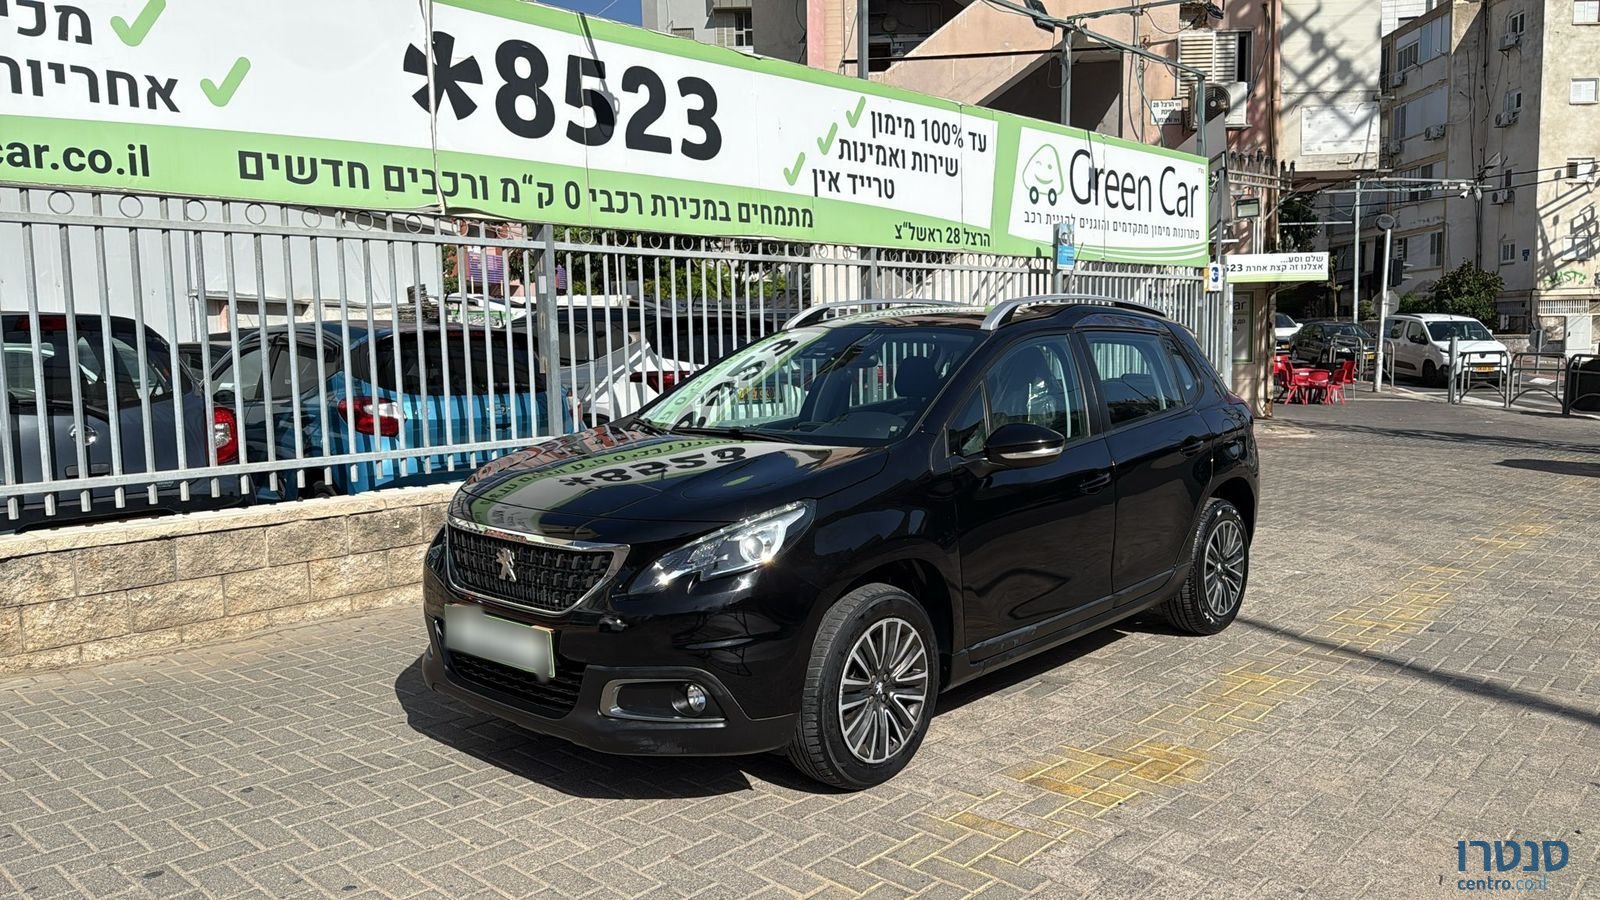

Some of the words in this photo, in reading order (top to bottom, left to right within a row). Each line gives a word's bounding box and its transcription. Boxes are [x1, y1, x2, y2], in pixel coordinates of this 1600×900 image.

[870, 111, 915, 139] מימון
[921, 119, 964, 148] 100%
[838, 138, 906, 169] ואמינות
[967, 131, 987, 153] עד
[0, 142, 150, 177] ar.co.il
[238, 150, 370, 190] חדשים
[911, 151, 959, 177] שירות
[383, 165, 489, 202] ורכבים
[812, 168, 841, 198] אין
[846, 173, 895, 200] טרייד
[1069, 149, 1152, 213] Green
[1159, 165, 1199, 219] Car
[589, 188, 643, 217] רכבי
[650, 194, 732, 222] במכירת
[737, 202, 814, 228] מתמחים
[1024, 210, 1042, 223] רכב
[1079, 217, 1110, 231] והוגנים
[945, 226, 961, 245] 28
[963, 227, 991, 247] הרצל
[1112, 220, 1149, 236] מתקדמים
[1151, 225, 1171, 238] מימון
[1172, 227, 1200, 240] פתרונות
[1245, 264, 1268, 272] אחרת
[1269, 264, 1287, 272] קצת
[1289, 263, 1298, 271] זה
[1301, 262, 1324, 271] אצלנו
[1305, 254, 1324, 263] שלם
